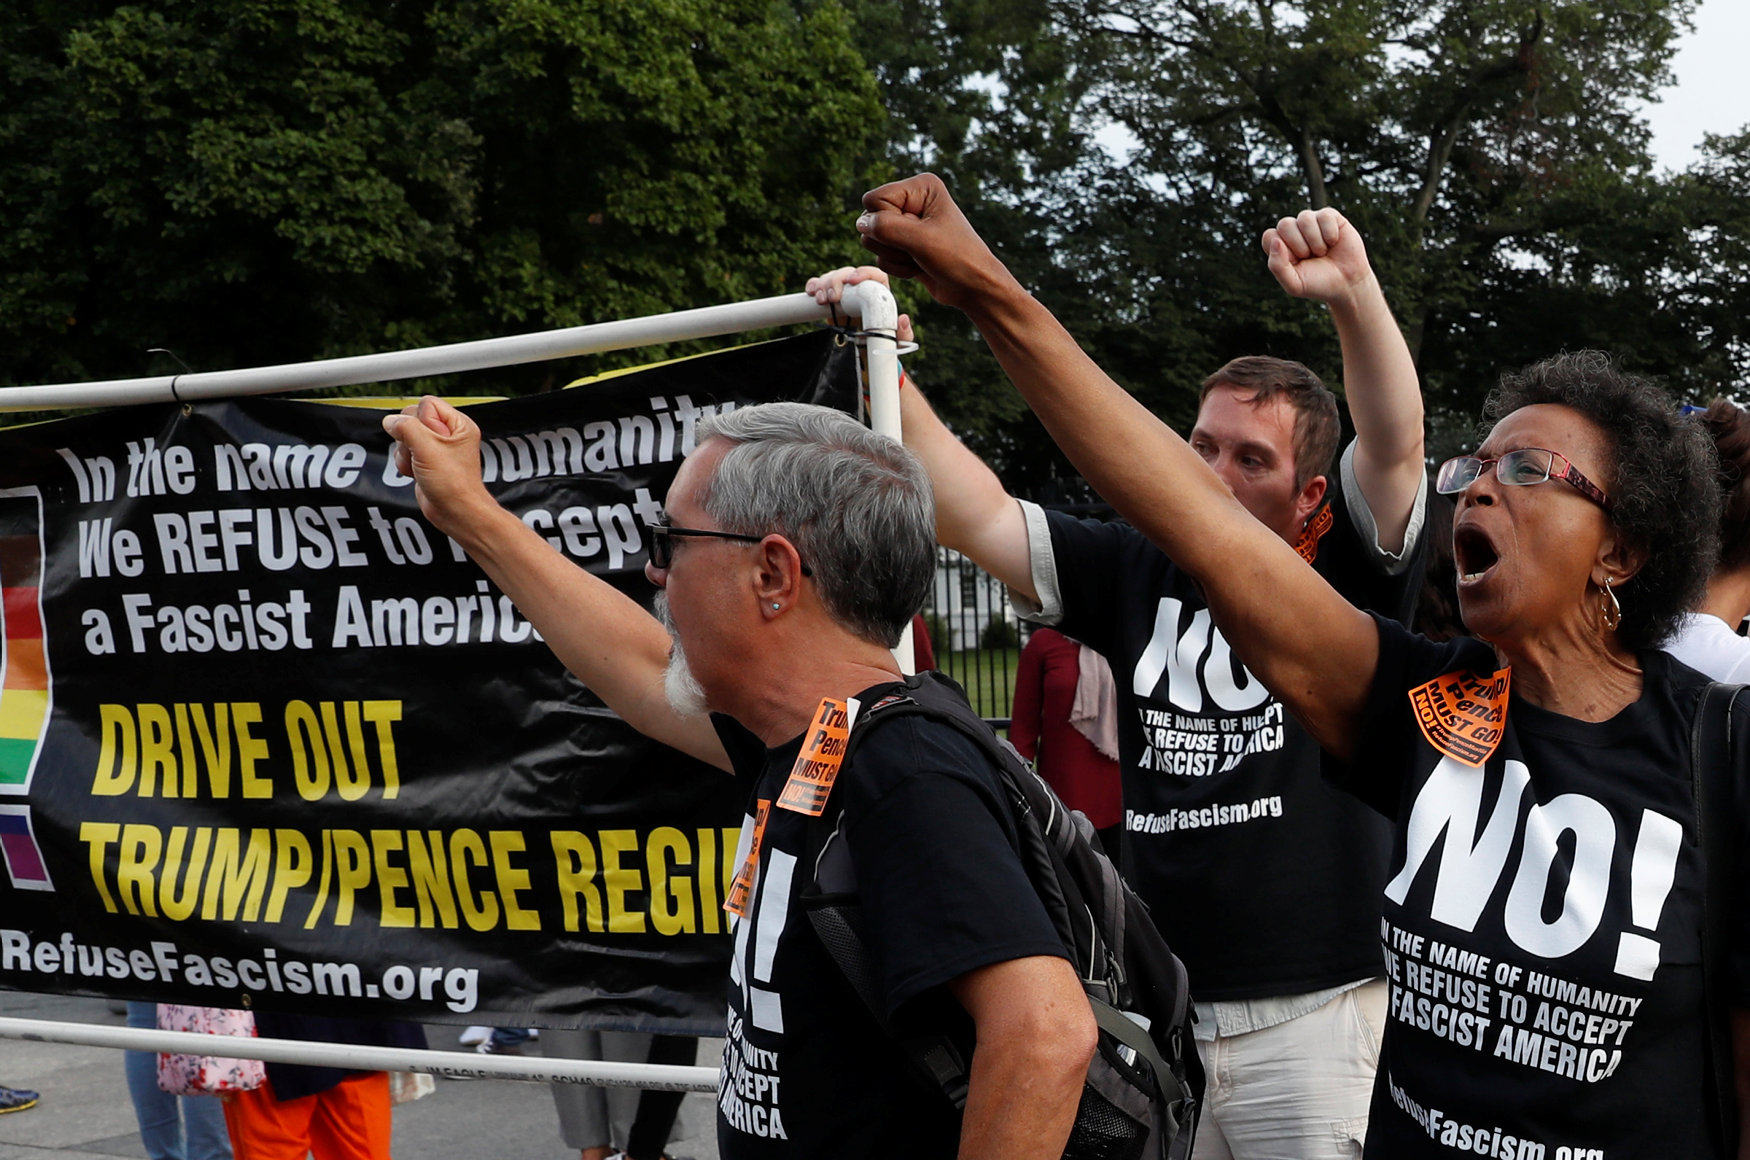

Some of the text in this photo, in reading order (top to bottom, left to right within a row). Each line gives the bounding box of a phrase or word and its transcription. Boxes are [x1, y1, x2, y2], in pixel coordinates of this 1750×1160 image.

[57, 447, 116, 503] In
[126, 437, 196, 498] the
[213, 441, 367, 492] name
[480, 394, 736, 484] umanit
[78, 517, 144, 578] We
[153, 505, 368, 575] REFUSE
[367, 506, 433, 565] to
[82, 579, 545, 655] a Fascist Americ
[810, 728, 846, 756] Penc
[818, 700, 848, 730] Tru
[1146, 709, 1172, 728] THE
[1175, 713, 1217, 732] NAME
[1220, 718, 1239, 732] OF
[1155, 728, 1219, 752] REFUSE
[1223, 734, 1245, 754] TO
[1415, 692, 1438, 729] NO!
[1428, 681, 1473, 731] MUST
[90, 699, 402, 802] DRIVE OUT
[793, 757, 828, 781] MUST
[79, 821, 542, 931] TRUMP/PENCE
[1383, 752, 1684, 982] NO!
[1, 929, 480, 1013] RefuseFascism.org
[1393, 925, 1425, 959] THE
[1429, 940, 1491, 979] NAME
[1494, 962, 1523, 988] OF
[1527, 970, 1643, 1018] HUMANITY
[1406, 959, 1491, 1015] REFUSE
[1498, 989, 1528, 1025] TO
[1533, 1001, 1634, 1046] ACCEPT
[1391, 983, 1491, 1052] FASCIST
[1493, 1024, 1622, 1084] AMERICA
